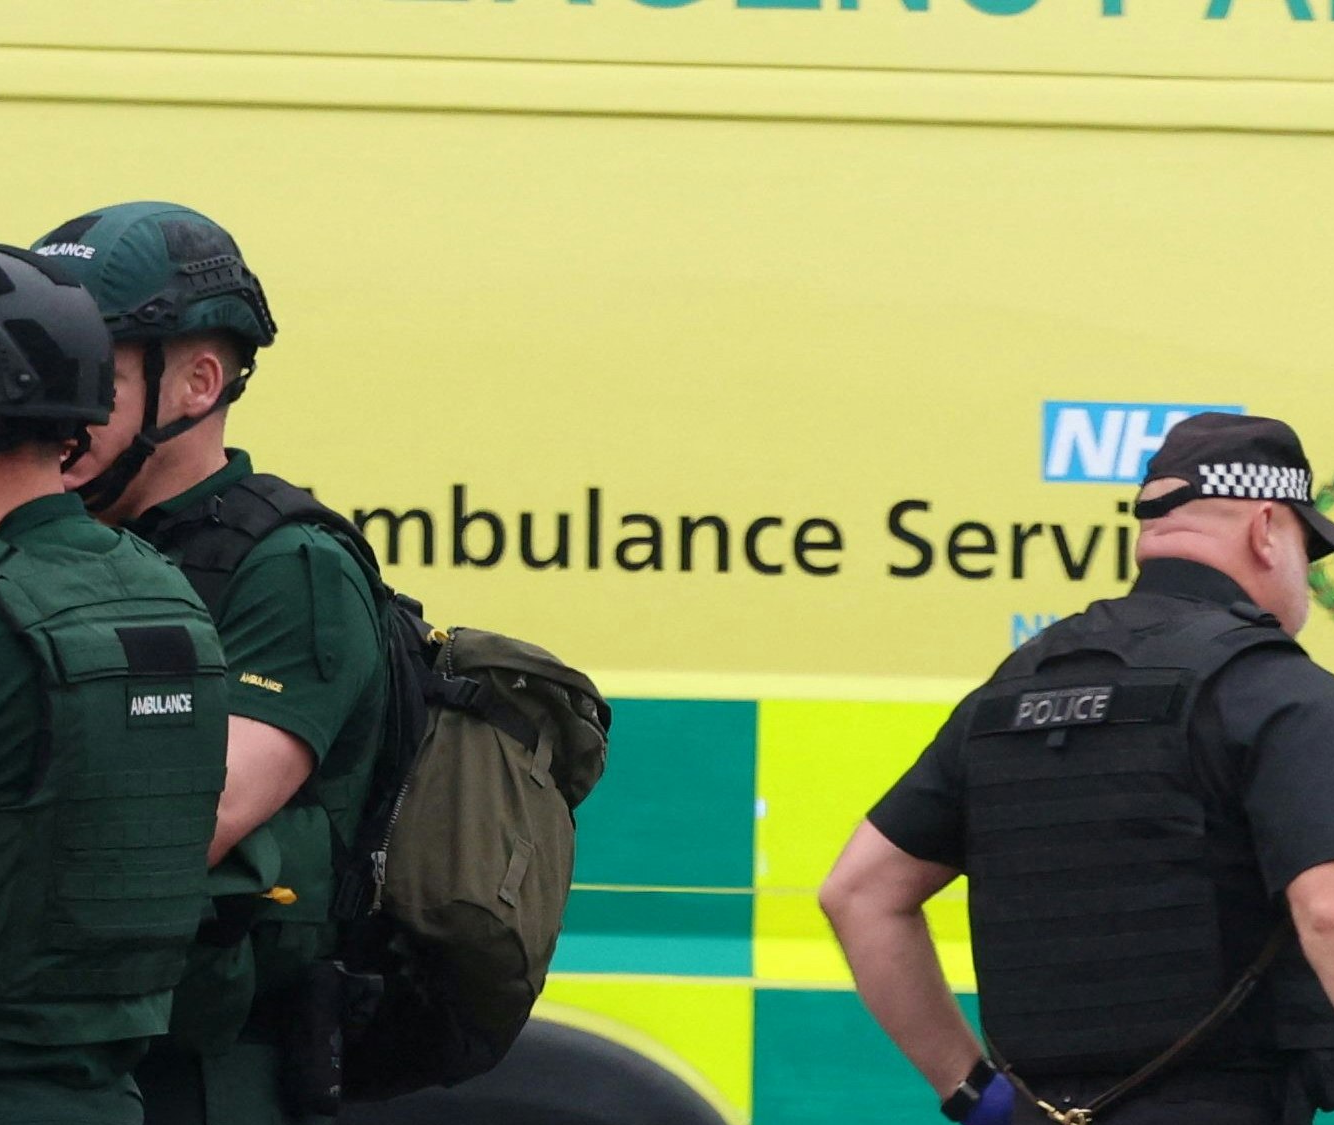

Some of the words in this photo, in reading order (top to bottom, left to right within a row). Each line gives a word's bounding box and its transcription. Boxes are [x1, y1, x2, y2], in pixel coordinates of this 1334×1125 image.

[1045, 408, 1191, 479] NH
[305, 484, 844, 575] mbulance
[886, 499, 1129, 581] Servi
[130, 693, 193, 716] AMBULANCE
[1014, 695, 1110, 727] POLICE
